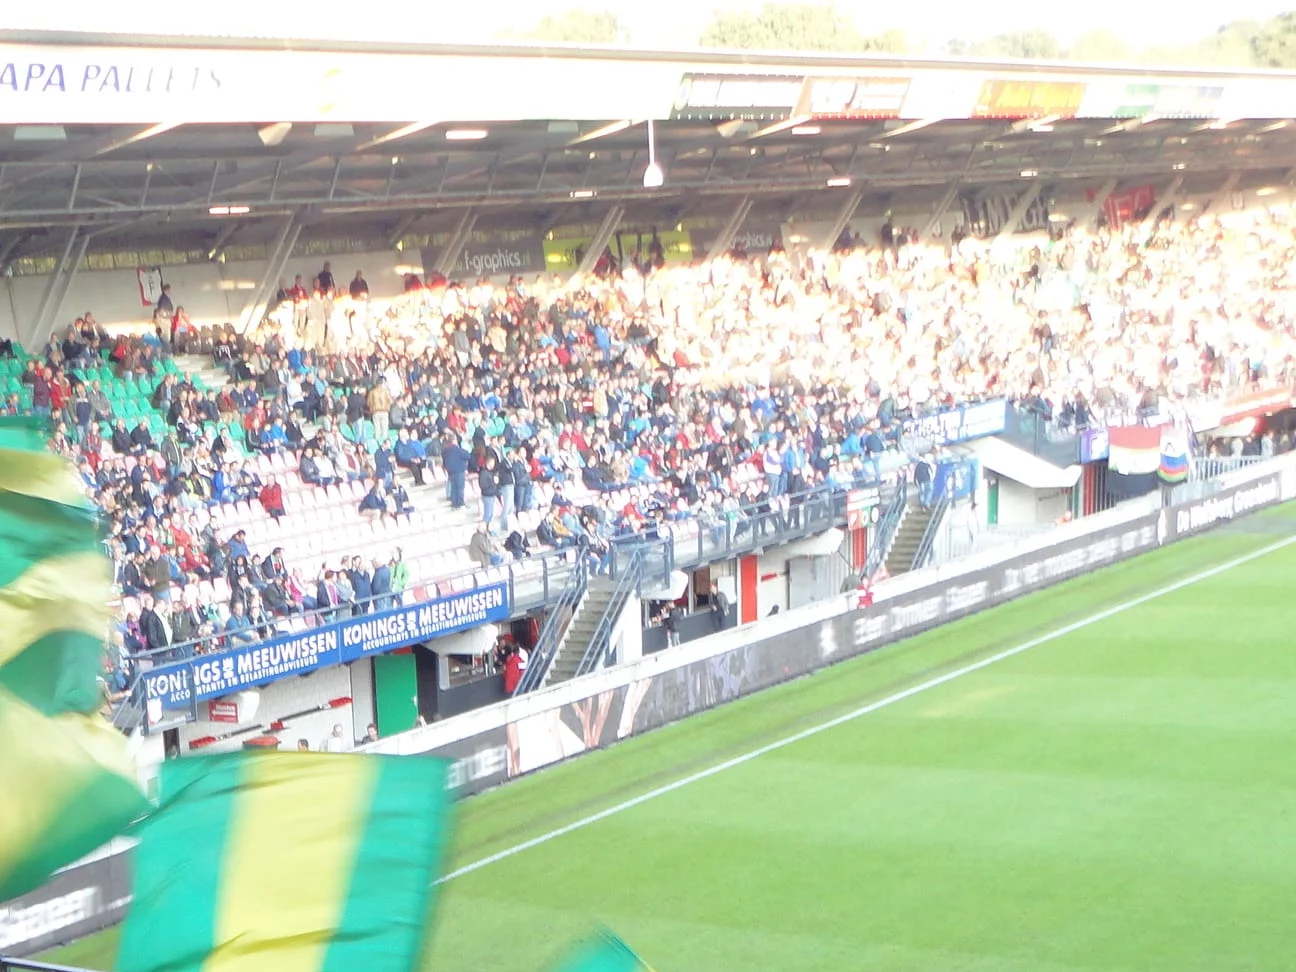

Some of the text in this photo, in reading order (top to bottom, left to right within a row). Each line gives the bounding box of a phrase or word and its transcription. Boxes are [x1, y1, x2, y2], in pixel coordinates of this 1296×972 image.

[343, 613, 404, 647] KONINGS
[419, 588, 502, 628] MEEUWISSEN
[238, 630, 337, 675] MEEUWISSEN
[170, 679, 225, 704] ACCONTANTS
